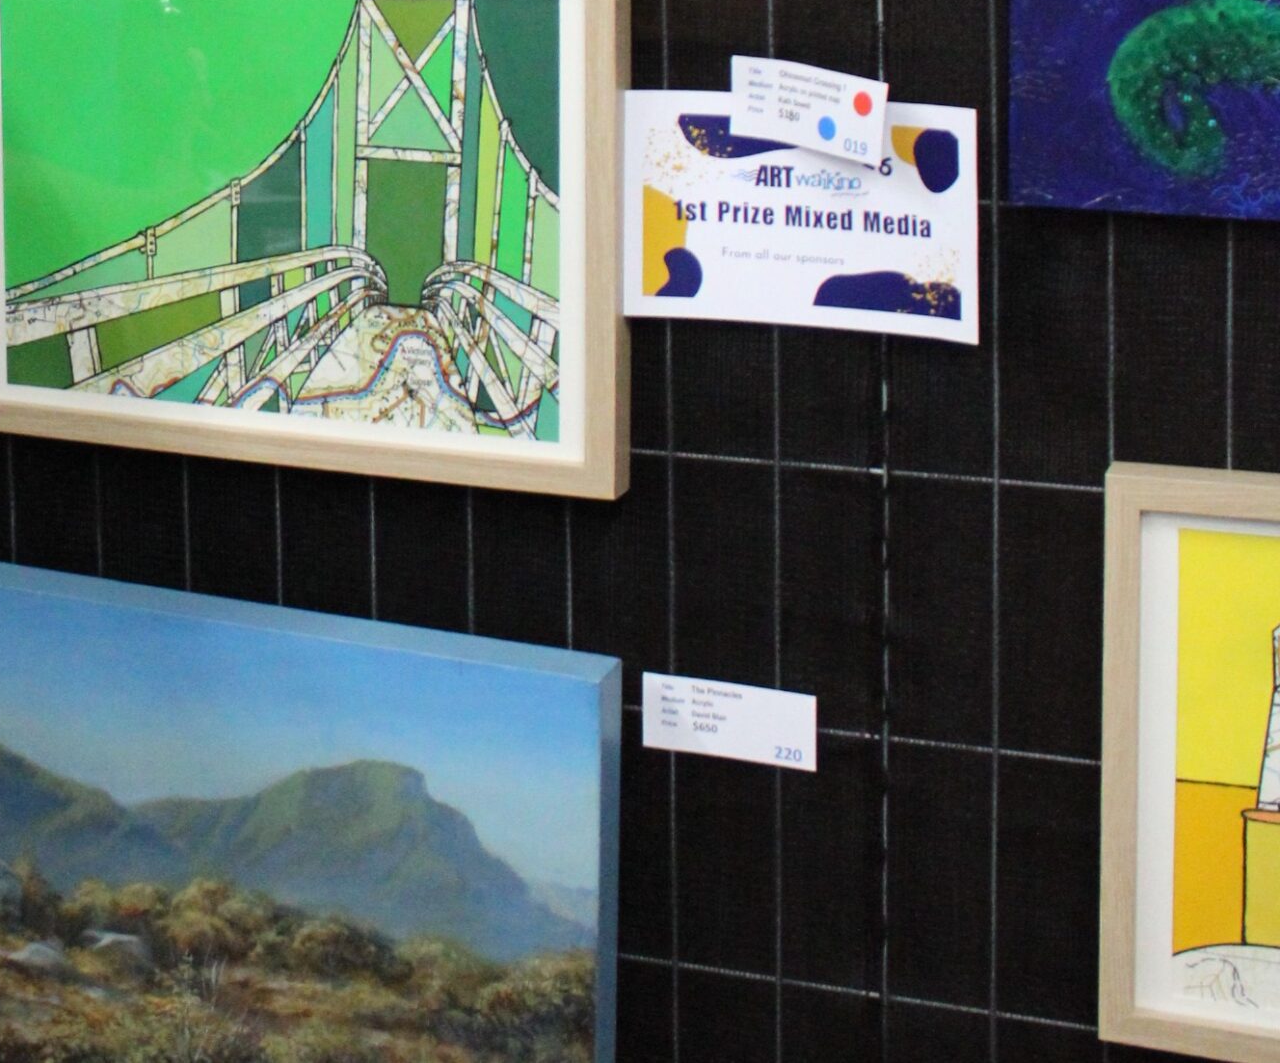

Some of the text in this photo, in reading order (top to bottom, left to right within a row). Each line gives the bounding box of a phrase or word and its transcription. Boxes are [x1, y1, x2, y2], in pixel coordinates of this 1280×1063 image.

[843, 137, 869, 156] 019
[754, 164, 796, 189] ART
[672, 198, 933, 239] 1st Prize Mixed Media
[721, 246, 845, 267] From all our sponsors
[691, 685, 705, 695] The
[692, 721, 718, 734] $650
[774, 745, 803, 763] 220
